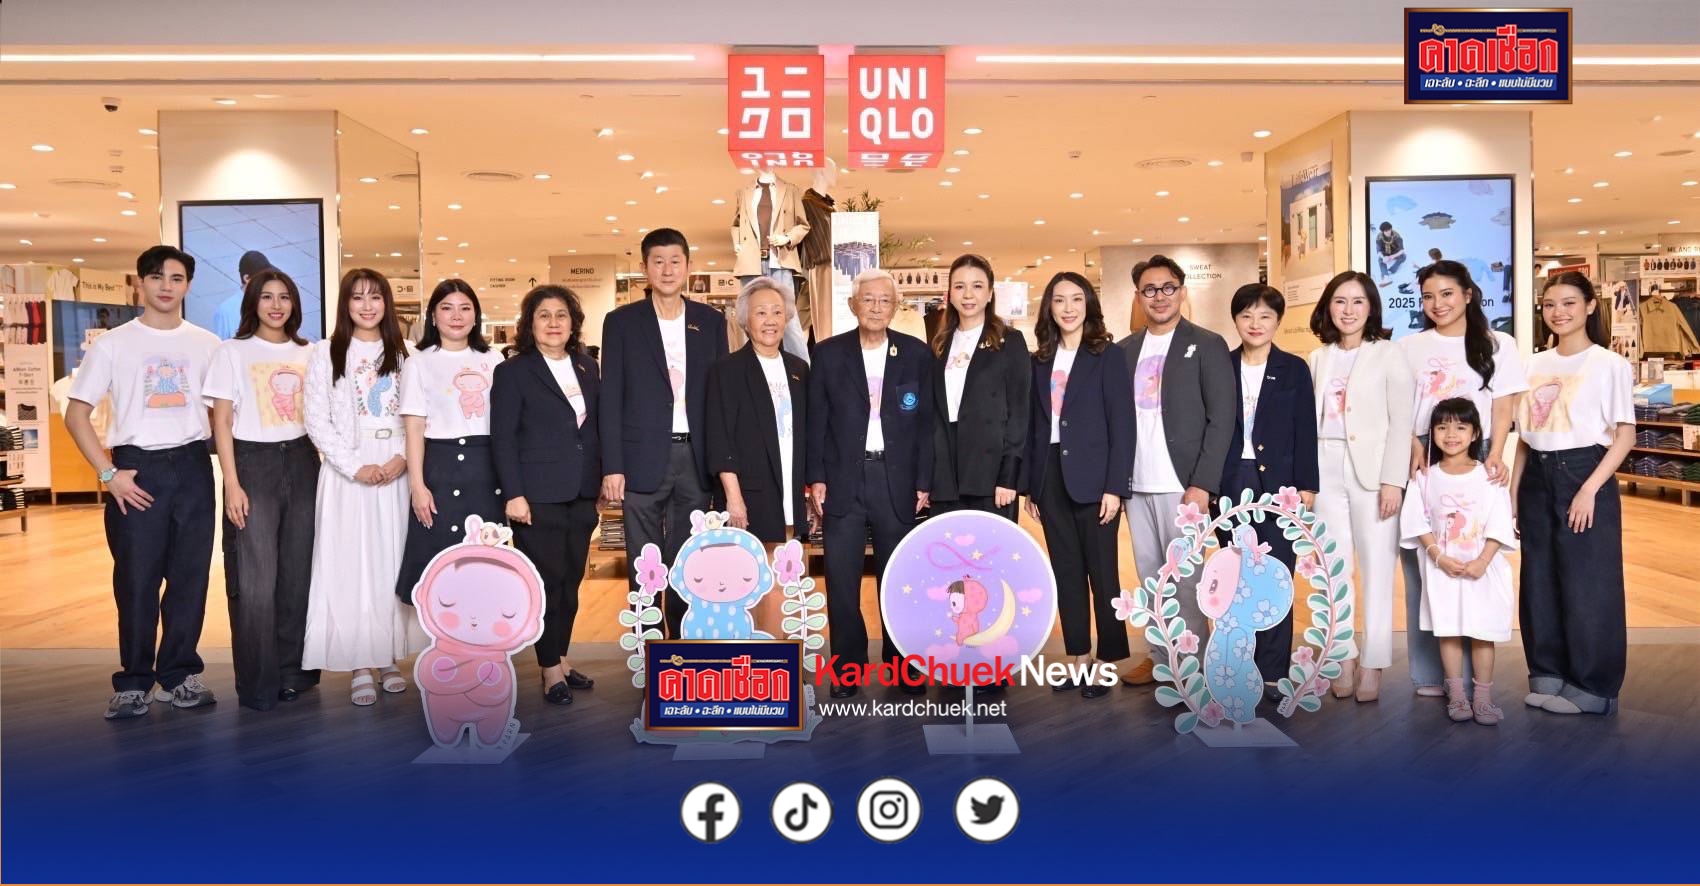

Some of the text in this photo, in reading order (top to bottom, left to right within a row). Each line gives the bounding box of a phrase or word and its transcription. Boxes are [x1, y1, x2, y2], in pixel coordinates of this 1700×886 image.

[859, 67, 927, 100] UNI
[859, 106, 934, 145] QLO
[570, 267, 595, 275] MERINO
[1388, 297, 1415, 309] 2025
